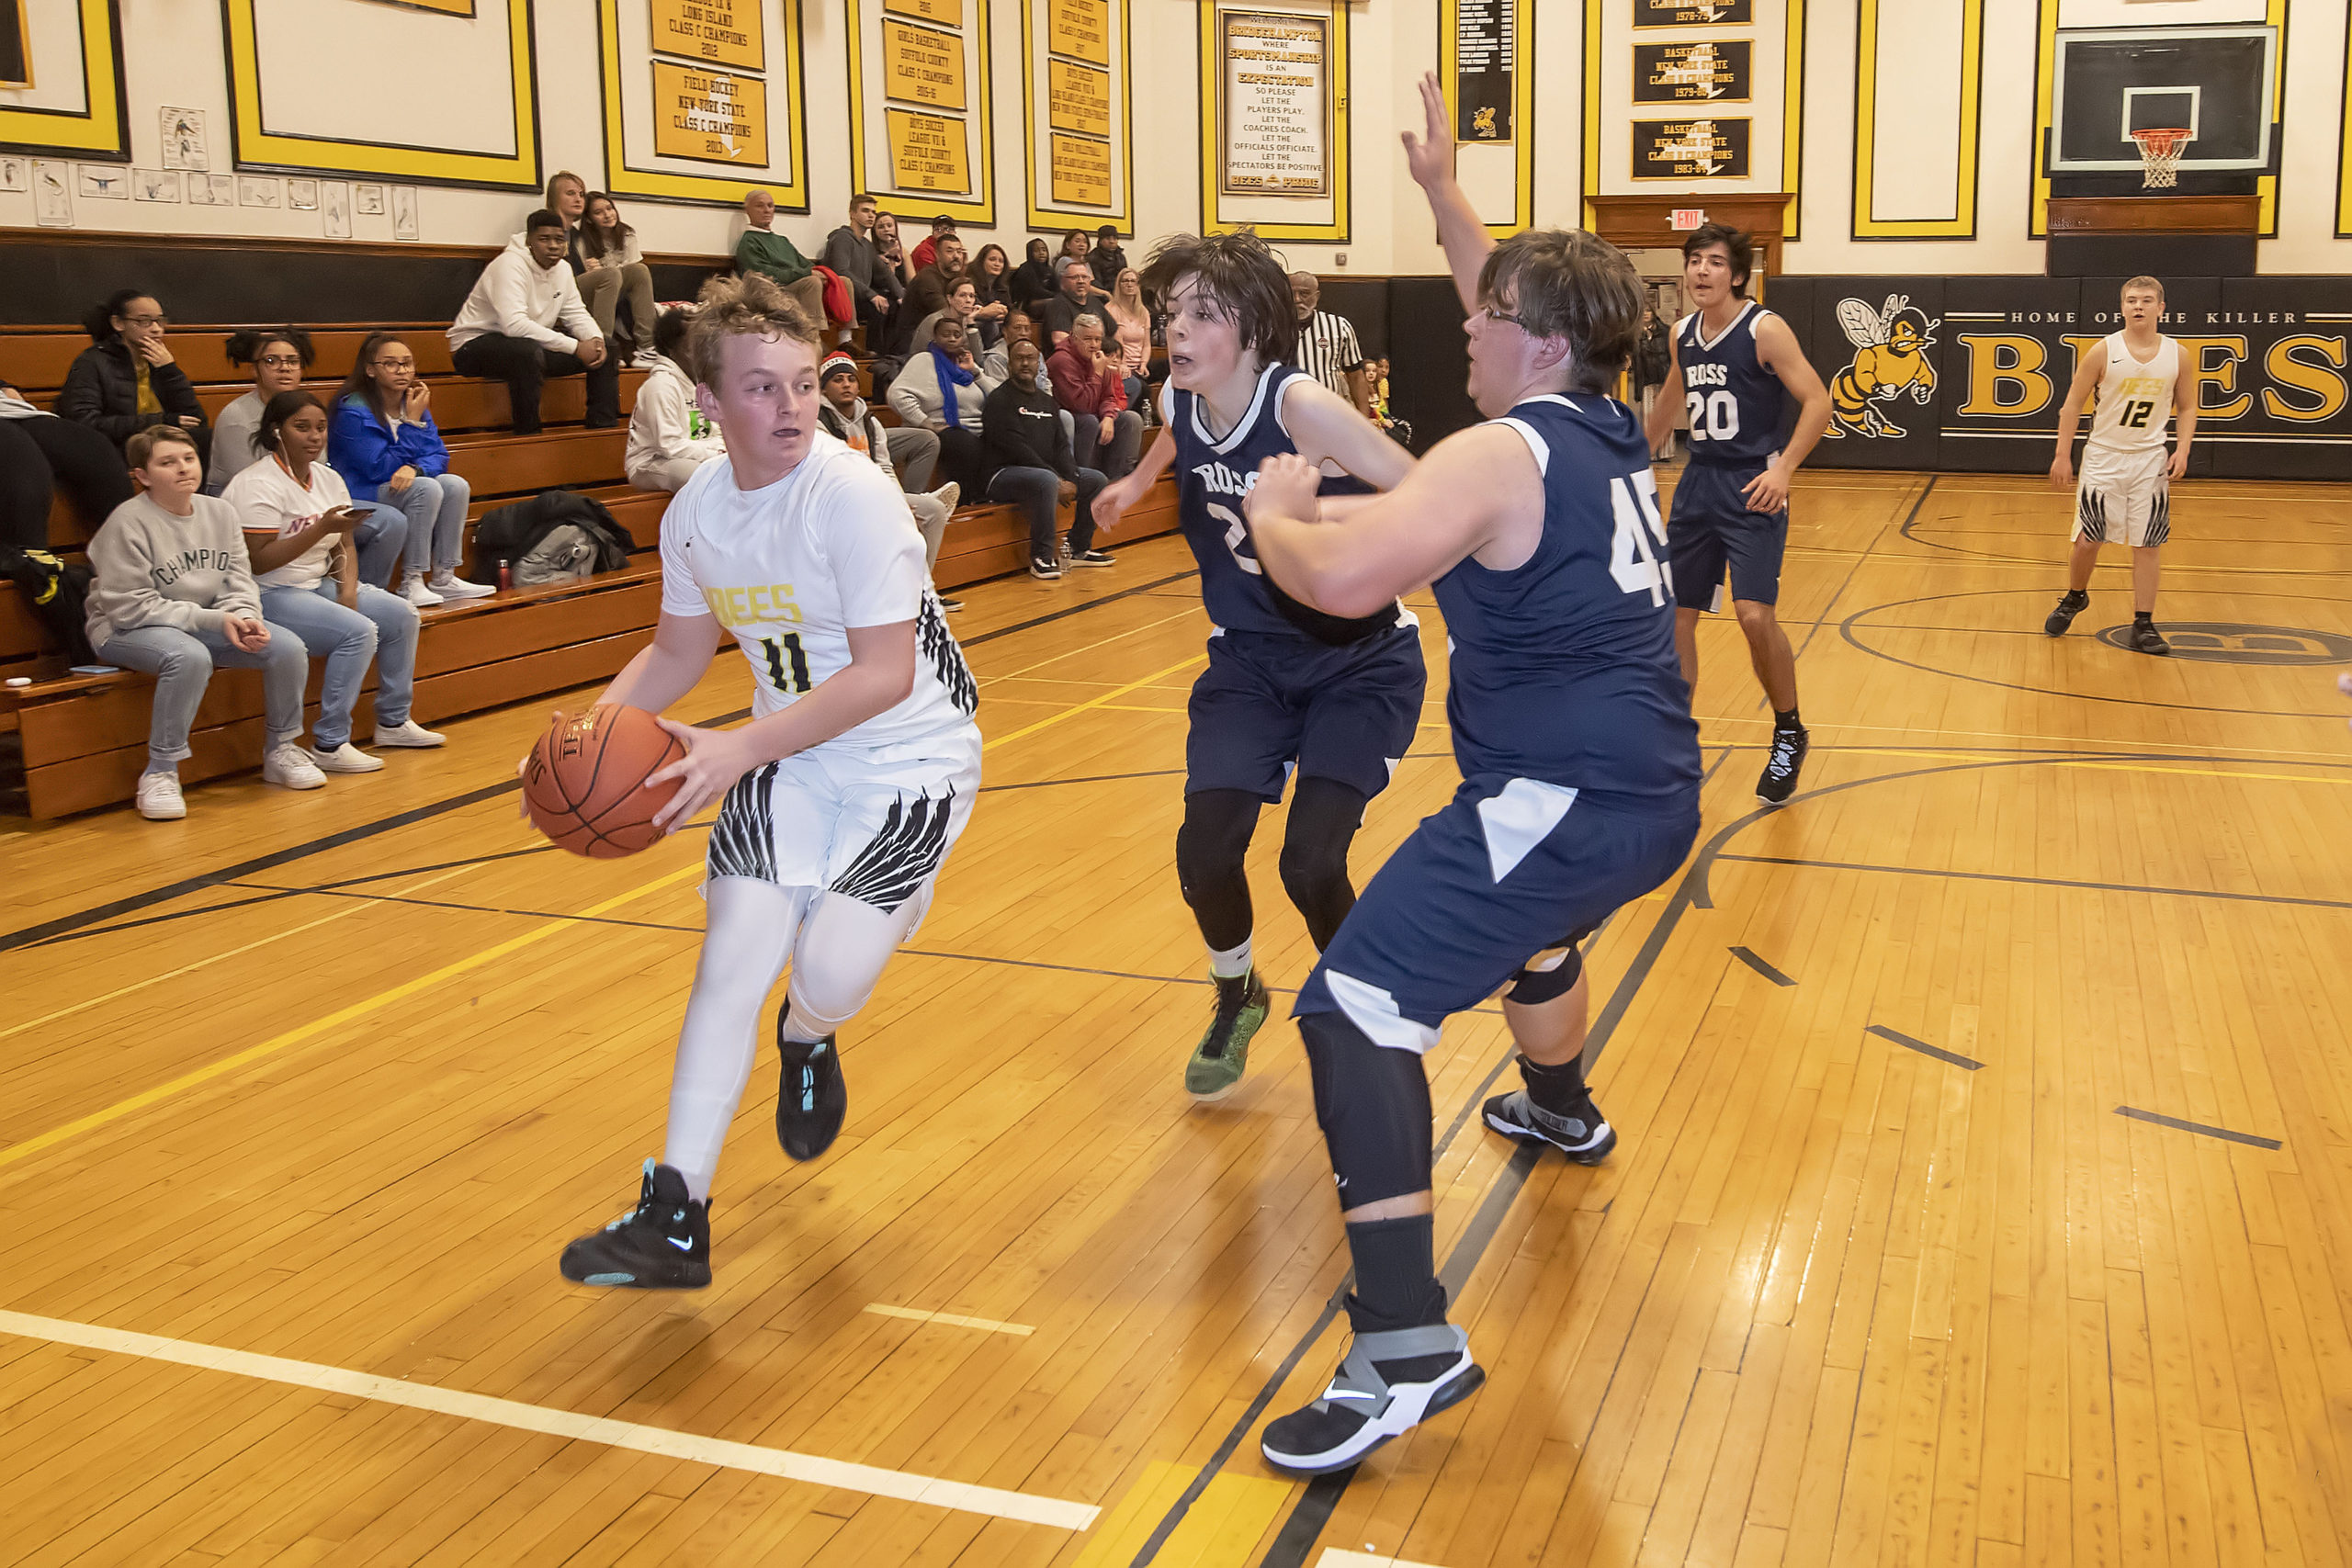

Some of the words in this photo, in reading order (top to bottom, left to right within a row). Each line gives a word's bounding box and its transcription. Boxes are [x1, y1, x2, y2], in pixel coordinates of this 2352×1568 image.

[683, 5, 703, 21] LONG
[706, 10, 733, 28] ISLAND
[669, 18, 694, 36] CLASS
[696, 25, 701, 38] C
[704, 26, 748, 46] CHAMPIONS
[1227, 25, 1322, 42] BRIDGEHAMPTON
[1227, 48, 1322, 63] SPORTSMANSHIP
[1664, 46, 1720, 57] BASKETBALL
[1656, 62, 1674, 72] NEW
[1676, 61, 1698, 70] YORK
[1702, 60, 1728, 70] STATE
[684, 75, 707, 92] FIELD
[710, 80, 739, 97] HOCKEY
[1238, 73, 1314, 86] EXPECTATION
[1649, 74, 1675, 85] CLASS
[1686, 73, 1735, 84] CHAMPIONS
[678, 96, 695, 109] NEW
[698, 97, 718, 114] YORK
[721, 102, 745, 118] STATE
[1247, 106, 1281, 114] PLAYERS
[1283, 107, 1305, 115] PLAY.
[673, 115, 698, 130] CLASS
[700, 118, 706, 132] C
[708, 119, 752, 138] CHAMPIONS
[1243, 124, 1279, 132] COACHES
[1663, 124, 1718, 134] BASKETBALL
[1234, 142, 1274, 151] OFFICIALS
[1276, 144, 1317, 152] OFFICIATE.
[1654, 138, 1673, 147] NEW
[1677, 138, 1697, 147] YORK
[1700, 137, 1727, 146] STATE
[1647, 152, 1674, 161] CLASS
[1685, 150, 1734, 161] CHAMPIONS
[1227, 161, 1274, 170] SPECTATORS
[1231, 175, 1263, 187] BEES
[1283, 176, 1319, 188] PRIDE
[1677, 210, 1699, 229] EXIT
[2011, 312, 2076, 322] HOME
[2207, 312, 2297, 323] KILLER
[1685, 363, 1728, 389] ROSS
[1957, 332, 2349, 423] BES
[1686, 390, 1739, 441] 20
[2119, 400, 2155, 429] 12
[758, 632, 813, 695] 11
